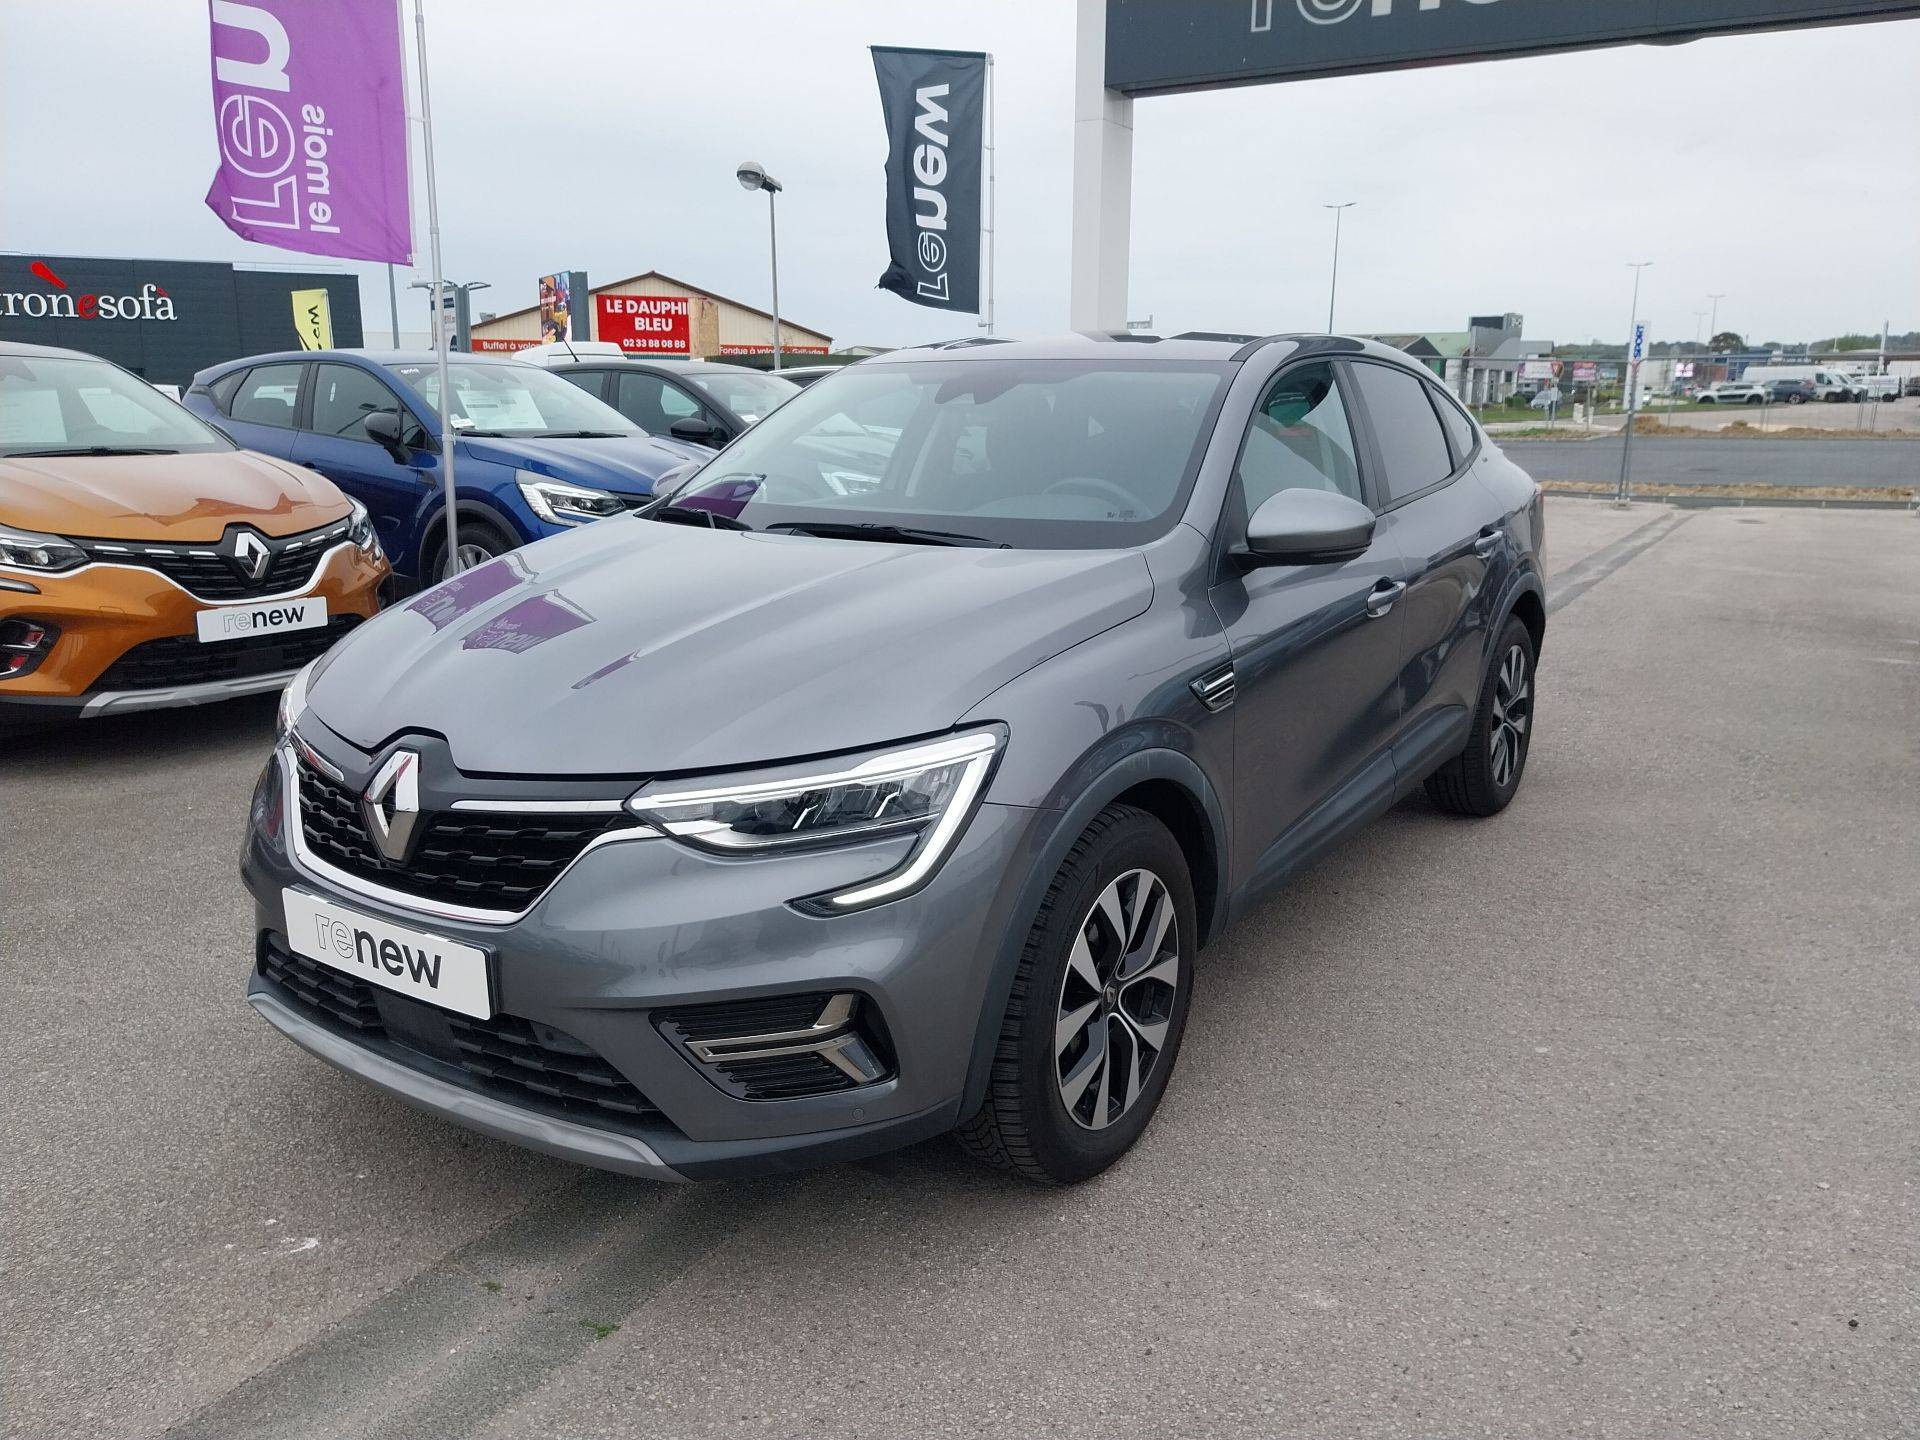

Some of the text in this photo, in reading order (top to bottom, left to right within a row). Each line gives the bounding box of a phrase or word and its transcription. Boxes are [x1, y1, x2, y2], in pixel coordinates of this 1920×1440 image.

[606, 299, 687, 315] LE DAUPHI
[634, 316, 673, 331] BLEU
[482, 340, 508, 350] Buffet
[623, 338, 686, 348] 02 33 88 08 88
[223, 606, 305, 633] renew
[315, 913, 442, 989] renew
